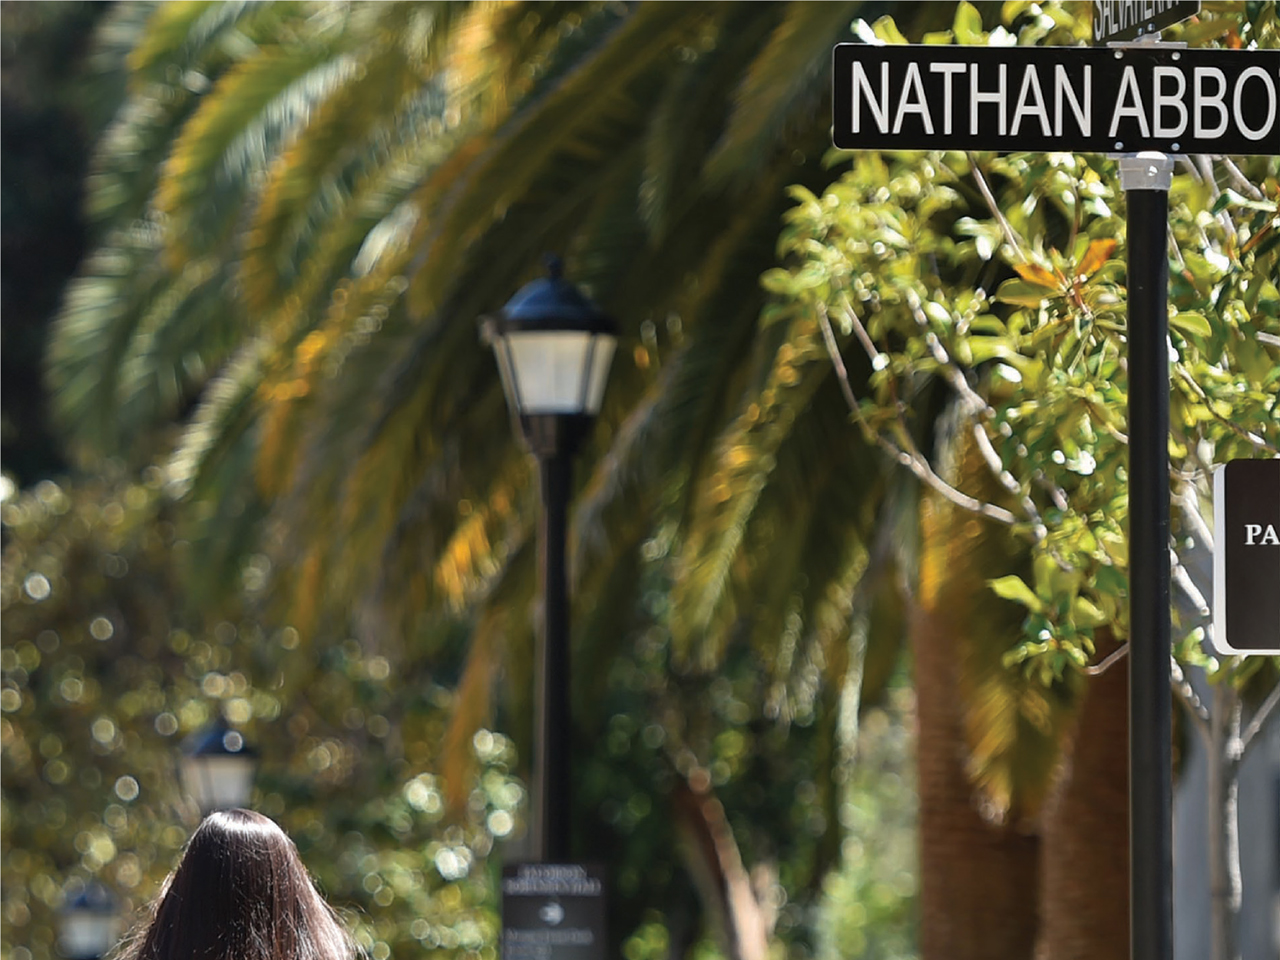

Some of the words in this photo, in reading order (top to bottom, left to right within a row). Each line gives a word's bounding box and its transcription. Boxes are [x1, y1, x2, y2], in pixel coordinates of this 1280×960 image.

[851, 60, 1092, 137] NATHAN
[1108, 65, 1280, 141] ABBO
[1244, 524, 1280, 545] PA
